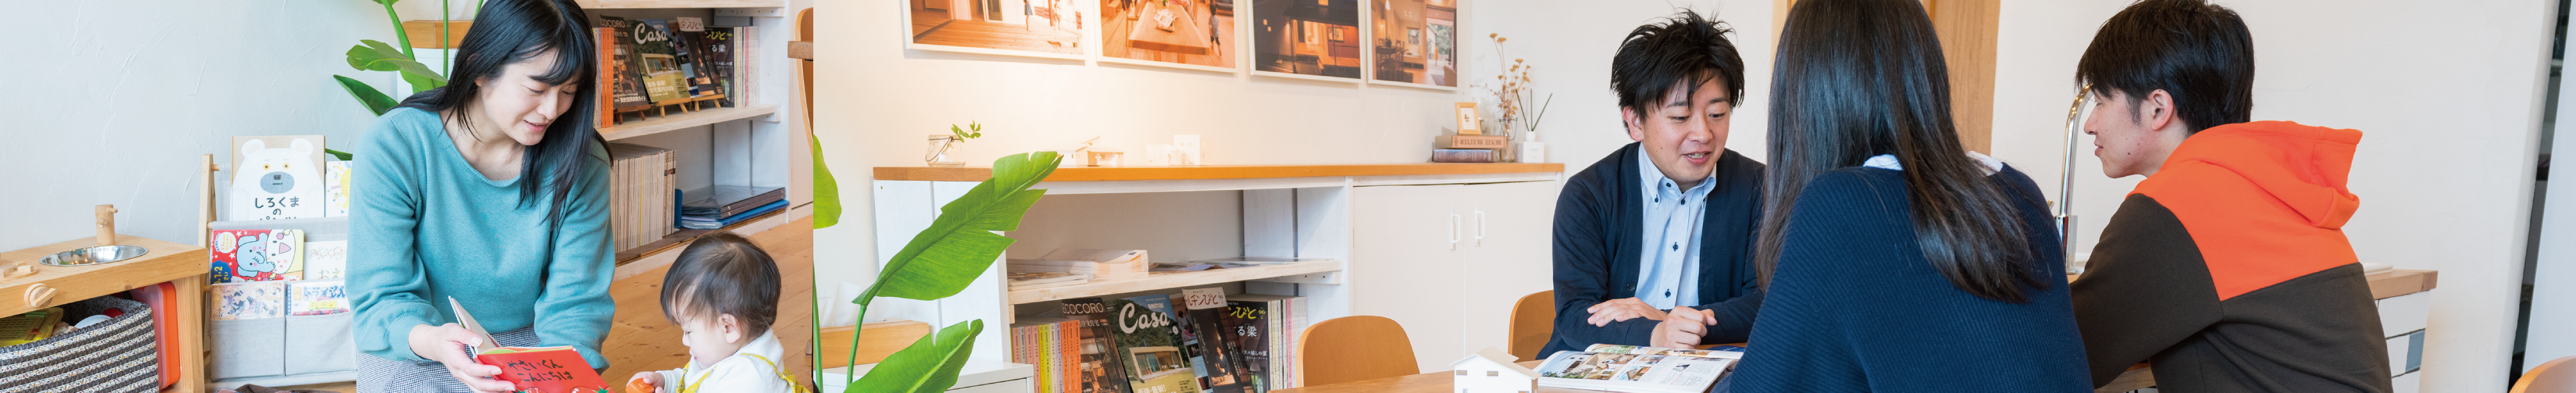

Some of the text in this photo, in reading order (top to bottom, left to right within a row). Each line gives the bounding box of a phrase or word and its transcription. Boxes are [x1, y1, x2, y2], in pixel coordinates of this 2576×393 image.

[635, 23, 668, 44] Casa
[255, 196, 299, 209] しろくま
[223, 271, 229, 281] さい
[303, 285, 346, 300] ドラえもん
[1119, 303, 1170, 334] Casa
[507, 359, 563, 371] やさいくん
[517, 371, 574, 382] こんにちは
